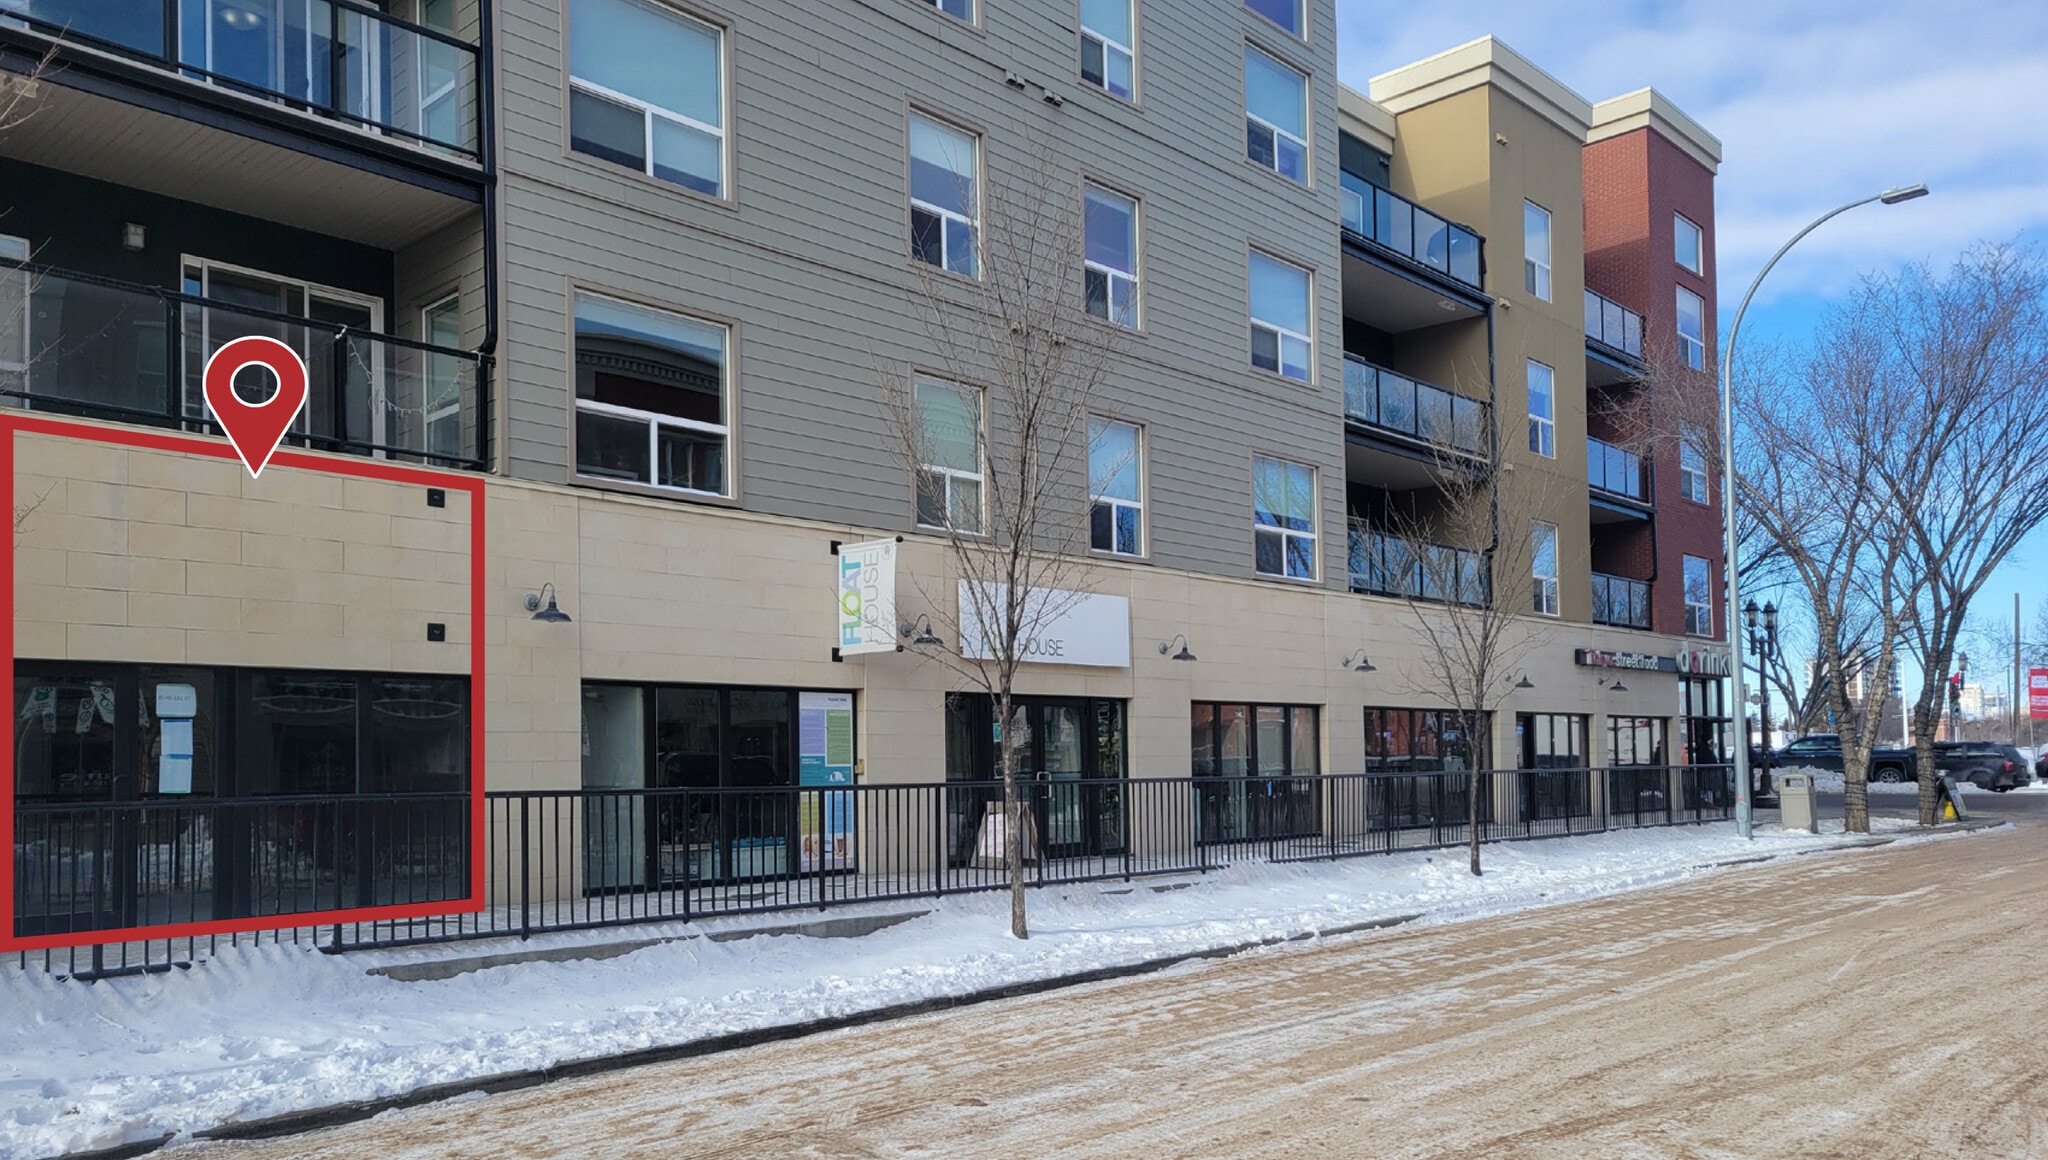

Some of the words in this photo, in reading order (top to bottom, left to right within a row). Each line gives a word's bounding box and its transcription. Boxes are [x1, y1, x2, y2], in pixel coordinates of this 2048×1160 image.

[842, 555, 861, 645] FLOAT
[864, 550, 879, 643] HOUSE
[1018, 636, 1064, 657] HOUSE
